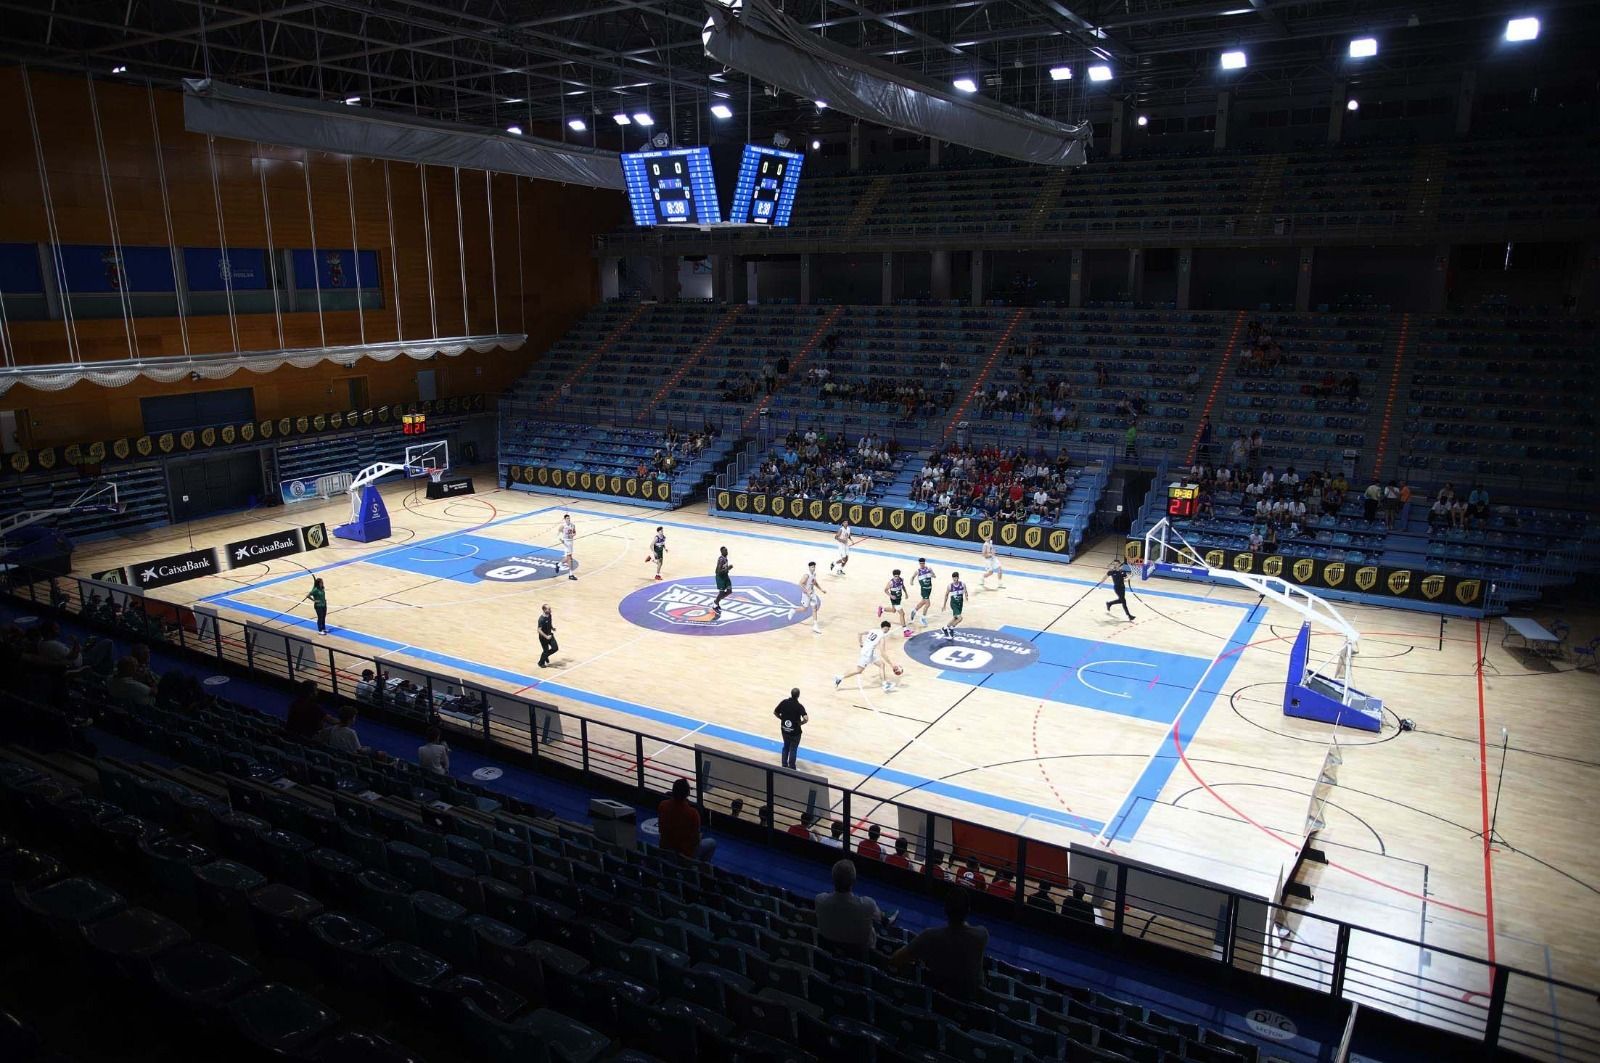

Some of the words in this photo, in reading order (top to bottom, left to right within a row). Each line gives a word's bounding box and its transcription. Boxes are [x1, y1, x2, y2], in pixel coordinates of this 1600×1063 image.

[652, 164, 660, 176] 0
[674, 162, 682, 174] 0
[666, 202, 685, 214] 8:38
[1174, 489, 1192, 499] 8:38
[1170, 499, 1190, 514] 21
[250, 538, 295, 556] CaixaBank
[159, 558, 210, 577] CaixaBank
[1328, 568, 1340, 580] 100
[1360, 572, 1372, 585] 100
[661, 588, 789, 616] JUNIOR
